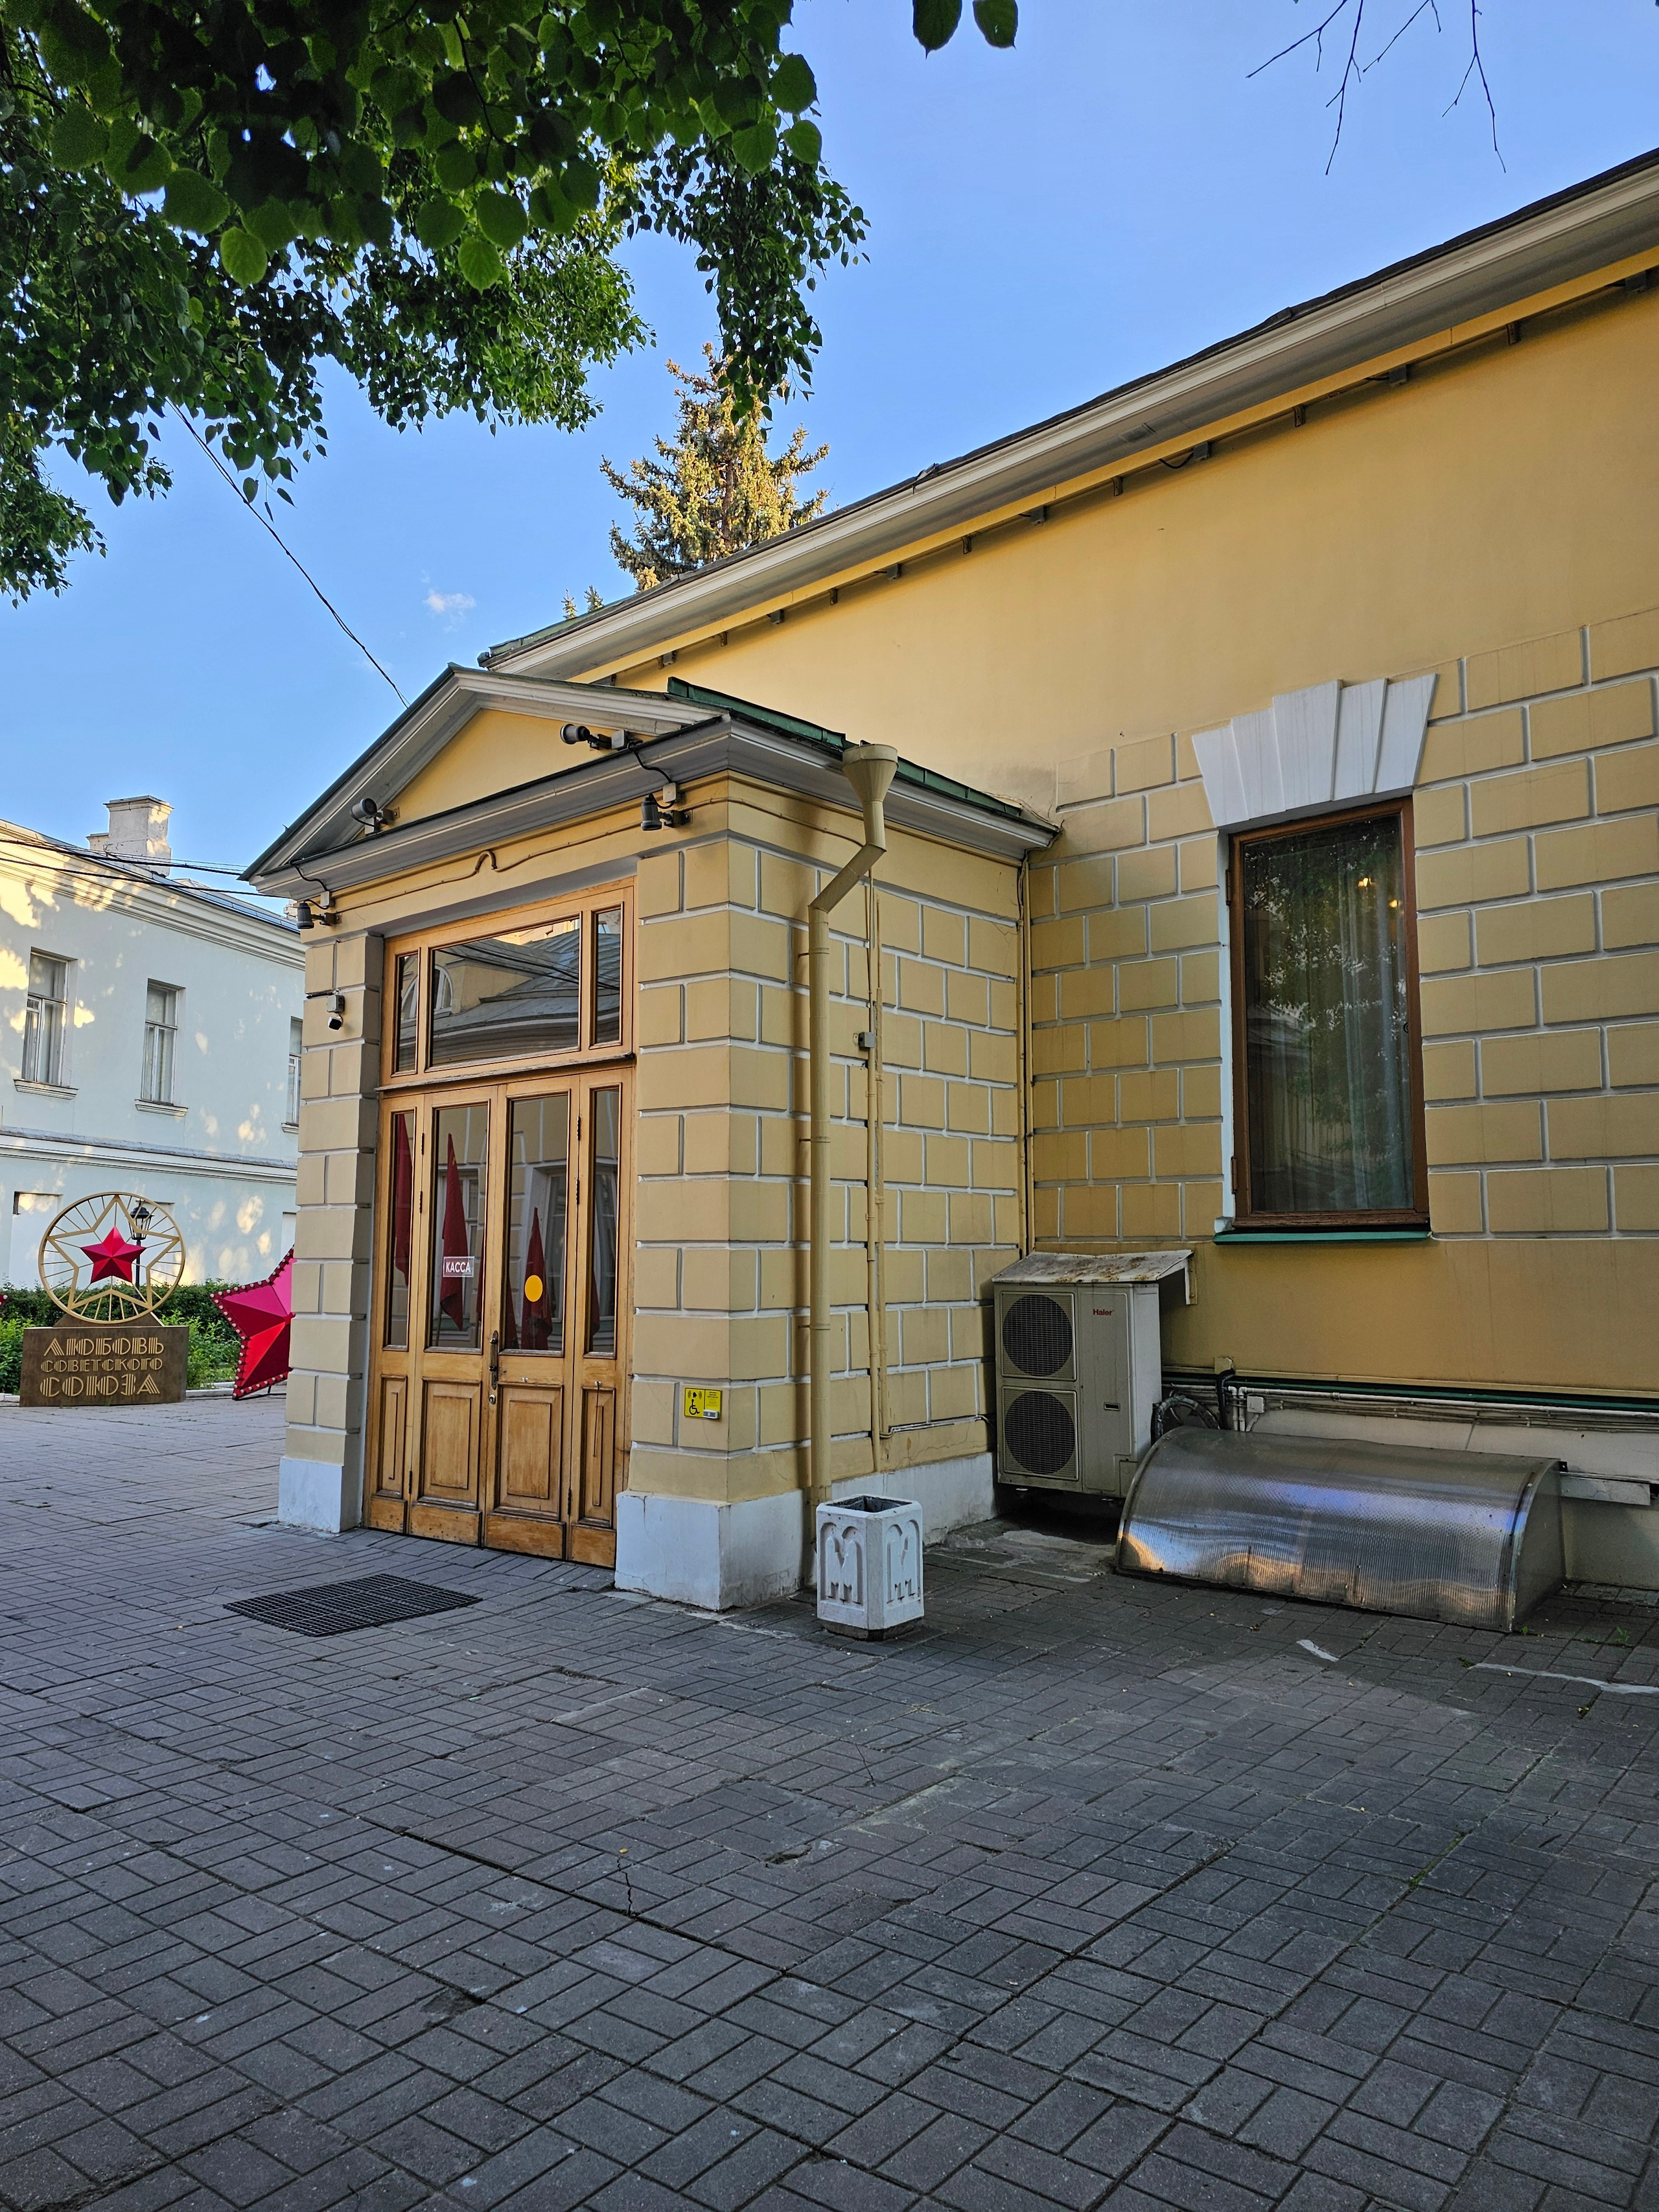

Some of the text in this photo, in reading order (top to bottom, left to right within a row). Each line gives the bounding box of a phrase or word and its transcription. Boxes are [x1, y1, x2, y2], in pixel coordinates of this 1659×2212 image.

[446, 1261, 470, 1273] КАССА
[43, 1337, 165, 1356] ЛЮБОВЬ
[41, 1358, 163, 1373] СОВЕТСКОГО
[40, 1373, 161, 1397] СОЮЗА
